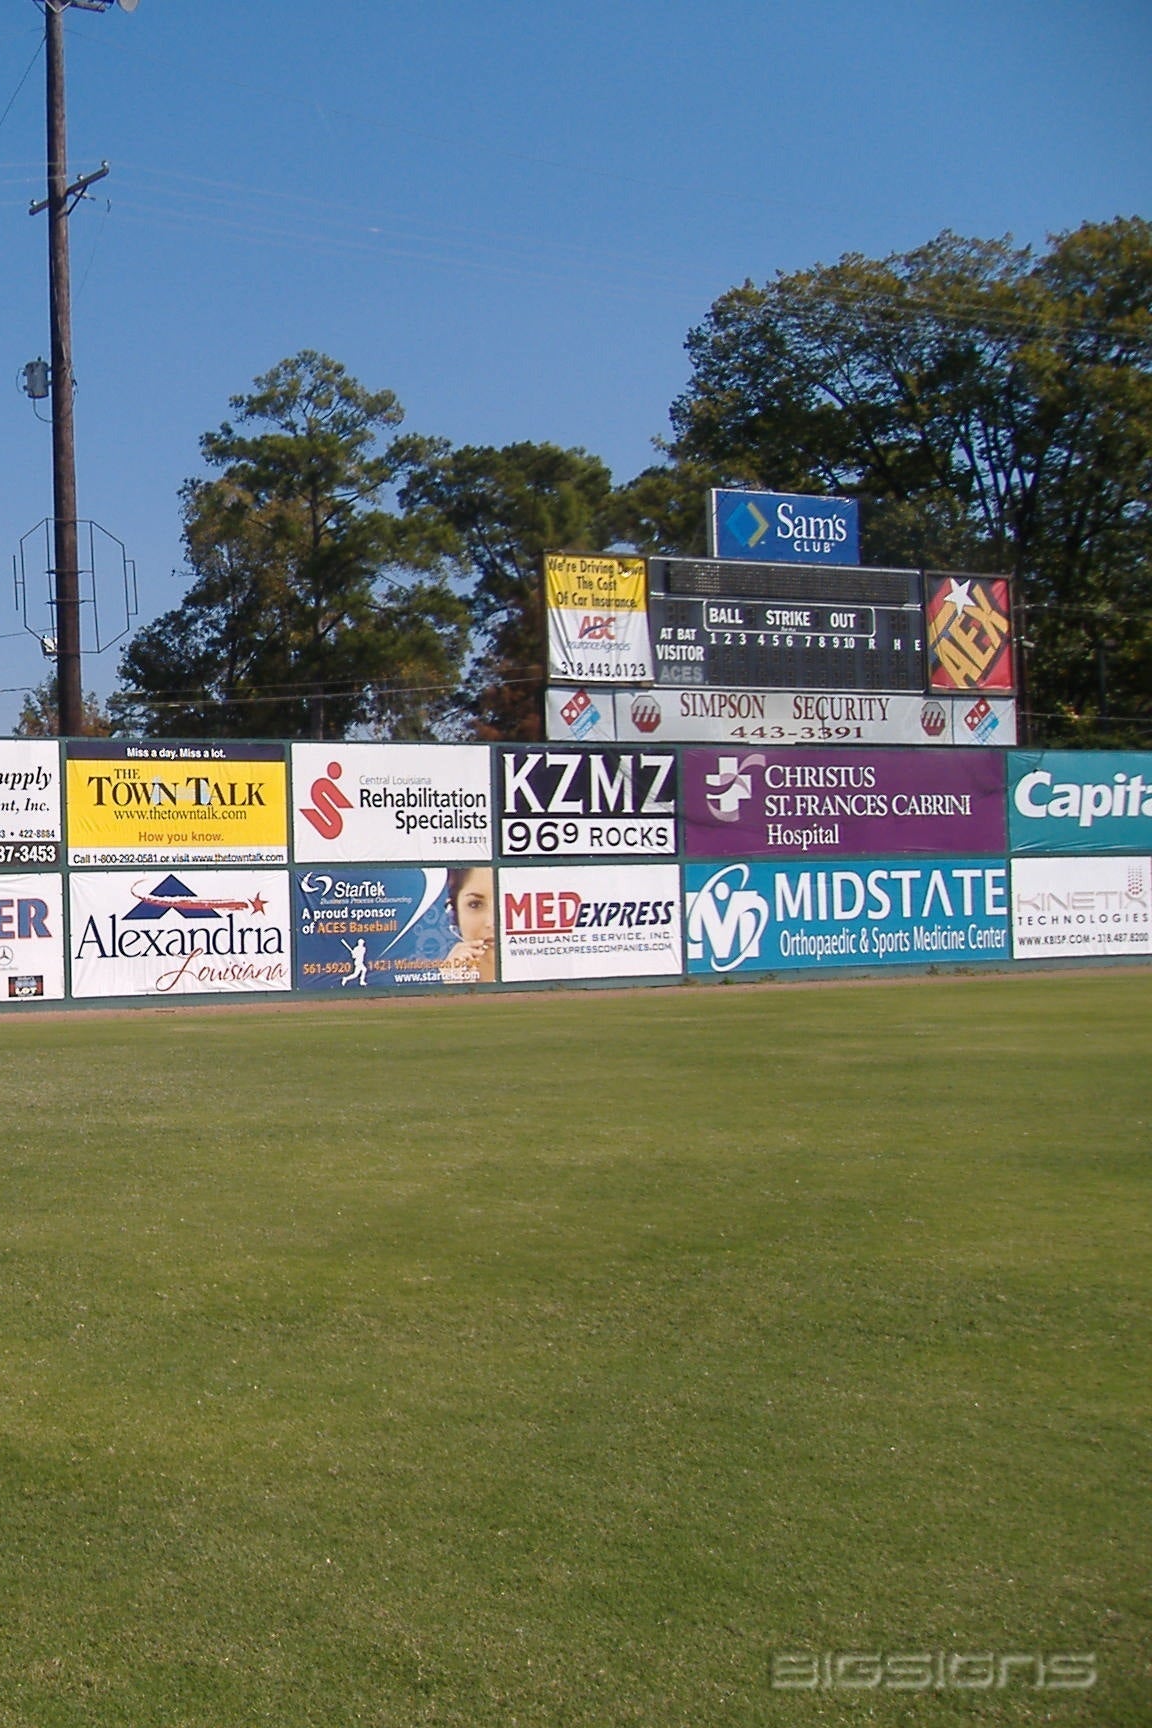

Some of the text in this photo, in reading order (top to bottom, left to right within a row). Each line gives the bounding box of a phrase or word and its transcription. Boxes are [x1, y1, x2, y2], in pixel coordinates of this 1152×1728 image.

[777, 503, 846, 542] Sam's
[794, 541, 832, 553] CLUB
[549, 559, 614, 576] We're Driving
[576, 576, 616, 591] The Cost
[557, 593, 638, 608] Of Car Insurance.
[710, 608, 855, 628] BALL STRIKE OUT
[579, 616, 616, 640] ABC
[660, 628, 695, 641] AT BAT
[710, 633, 921, 650] 1 2 3 4 5 6 7 8 9 10 R H E
[656, 645, 704, 661] VISITOR
[561, 662, 646, 677] 318.443.0123
[659, 666, 702, 682] ACES
[681, 692, 890, 721] SIMPSON SECURITY
[730, 726, 863, 740] 443-3391
[127, 748, 148, 757] Miss
[161, 749, 178, 760] day.
[180, 749, 201, 758] Miss
[212, 749, 226, 759] lot.
[114, 769, 140, 779] THE
[360, 776, 431, 785] Central Louisiana
[765, 765, 875, 789] CHRISTUS
[88, 777, 266, 806] TOWN TALK
[503, 753, 674, 814] KZMZ
[24, 798, 50, 811] Inc.
[360, 788, 486, 808] Rehabilitation
[765, 795, 971, 817] ST. FRANCES CABRINI
[114, 807, 247, 820] www.thetowntalk.com
[395, 810, 487, 834] Specialists
[139, 832, 224, 845] How you know.
[508, 822, 668, 852] 969 ROCKS
[767, 824, 839, 851] Hospital
[73, 854, 90, 864] Call
[172, 854, 190, 863] visit
[334, 881, 385, 897] StarTek
[775, 869, 1007, 921] MIDSTATE
[1016, 891, 1147, 912] KINETIX
[302, 907, 396, 921] A proud sponsor
[1018, 913, 1149, 925] TECHNOLOGIES
[302, 920, 397, 934] of ACES Baseball
[75, 914, 285, 960] Alexandria
[509, 931, 673, 944] AMBULANCE INC.
[780, 923, 1005, 960] Orthopaedic & Sports Medicine Center
[156, 948, 288, 991] Louisiana
[303, 962, 350, 974] 561-5920
